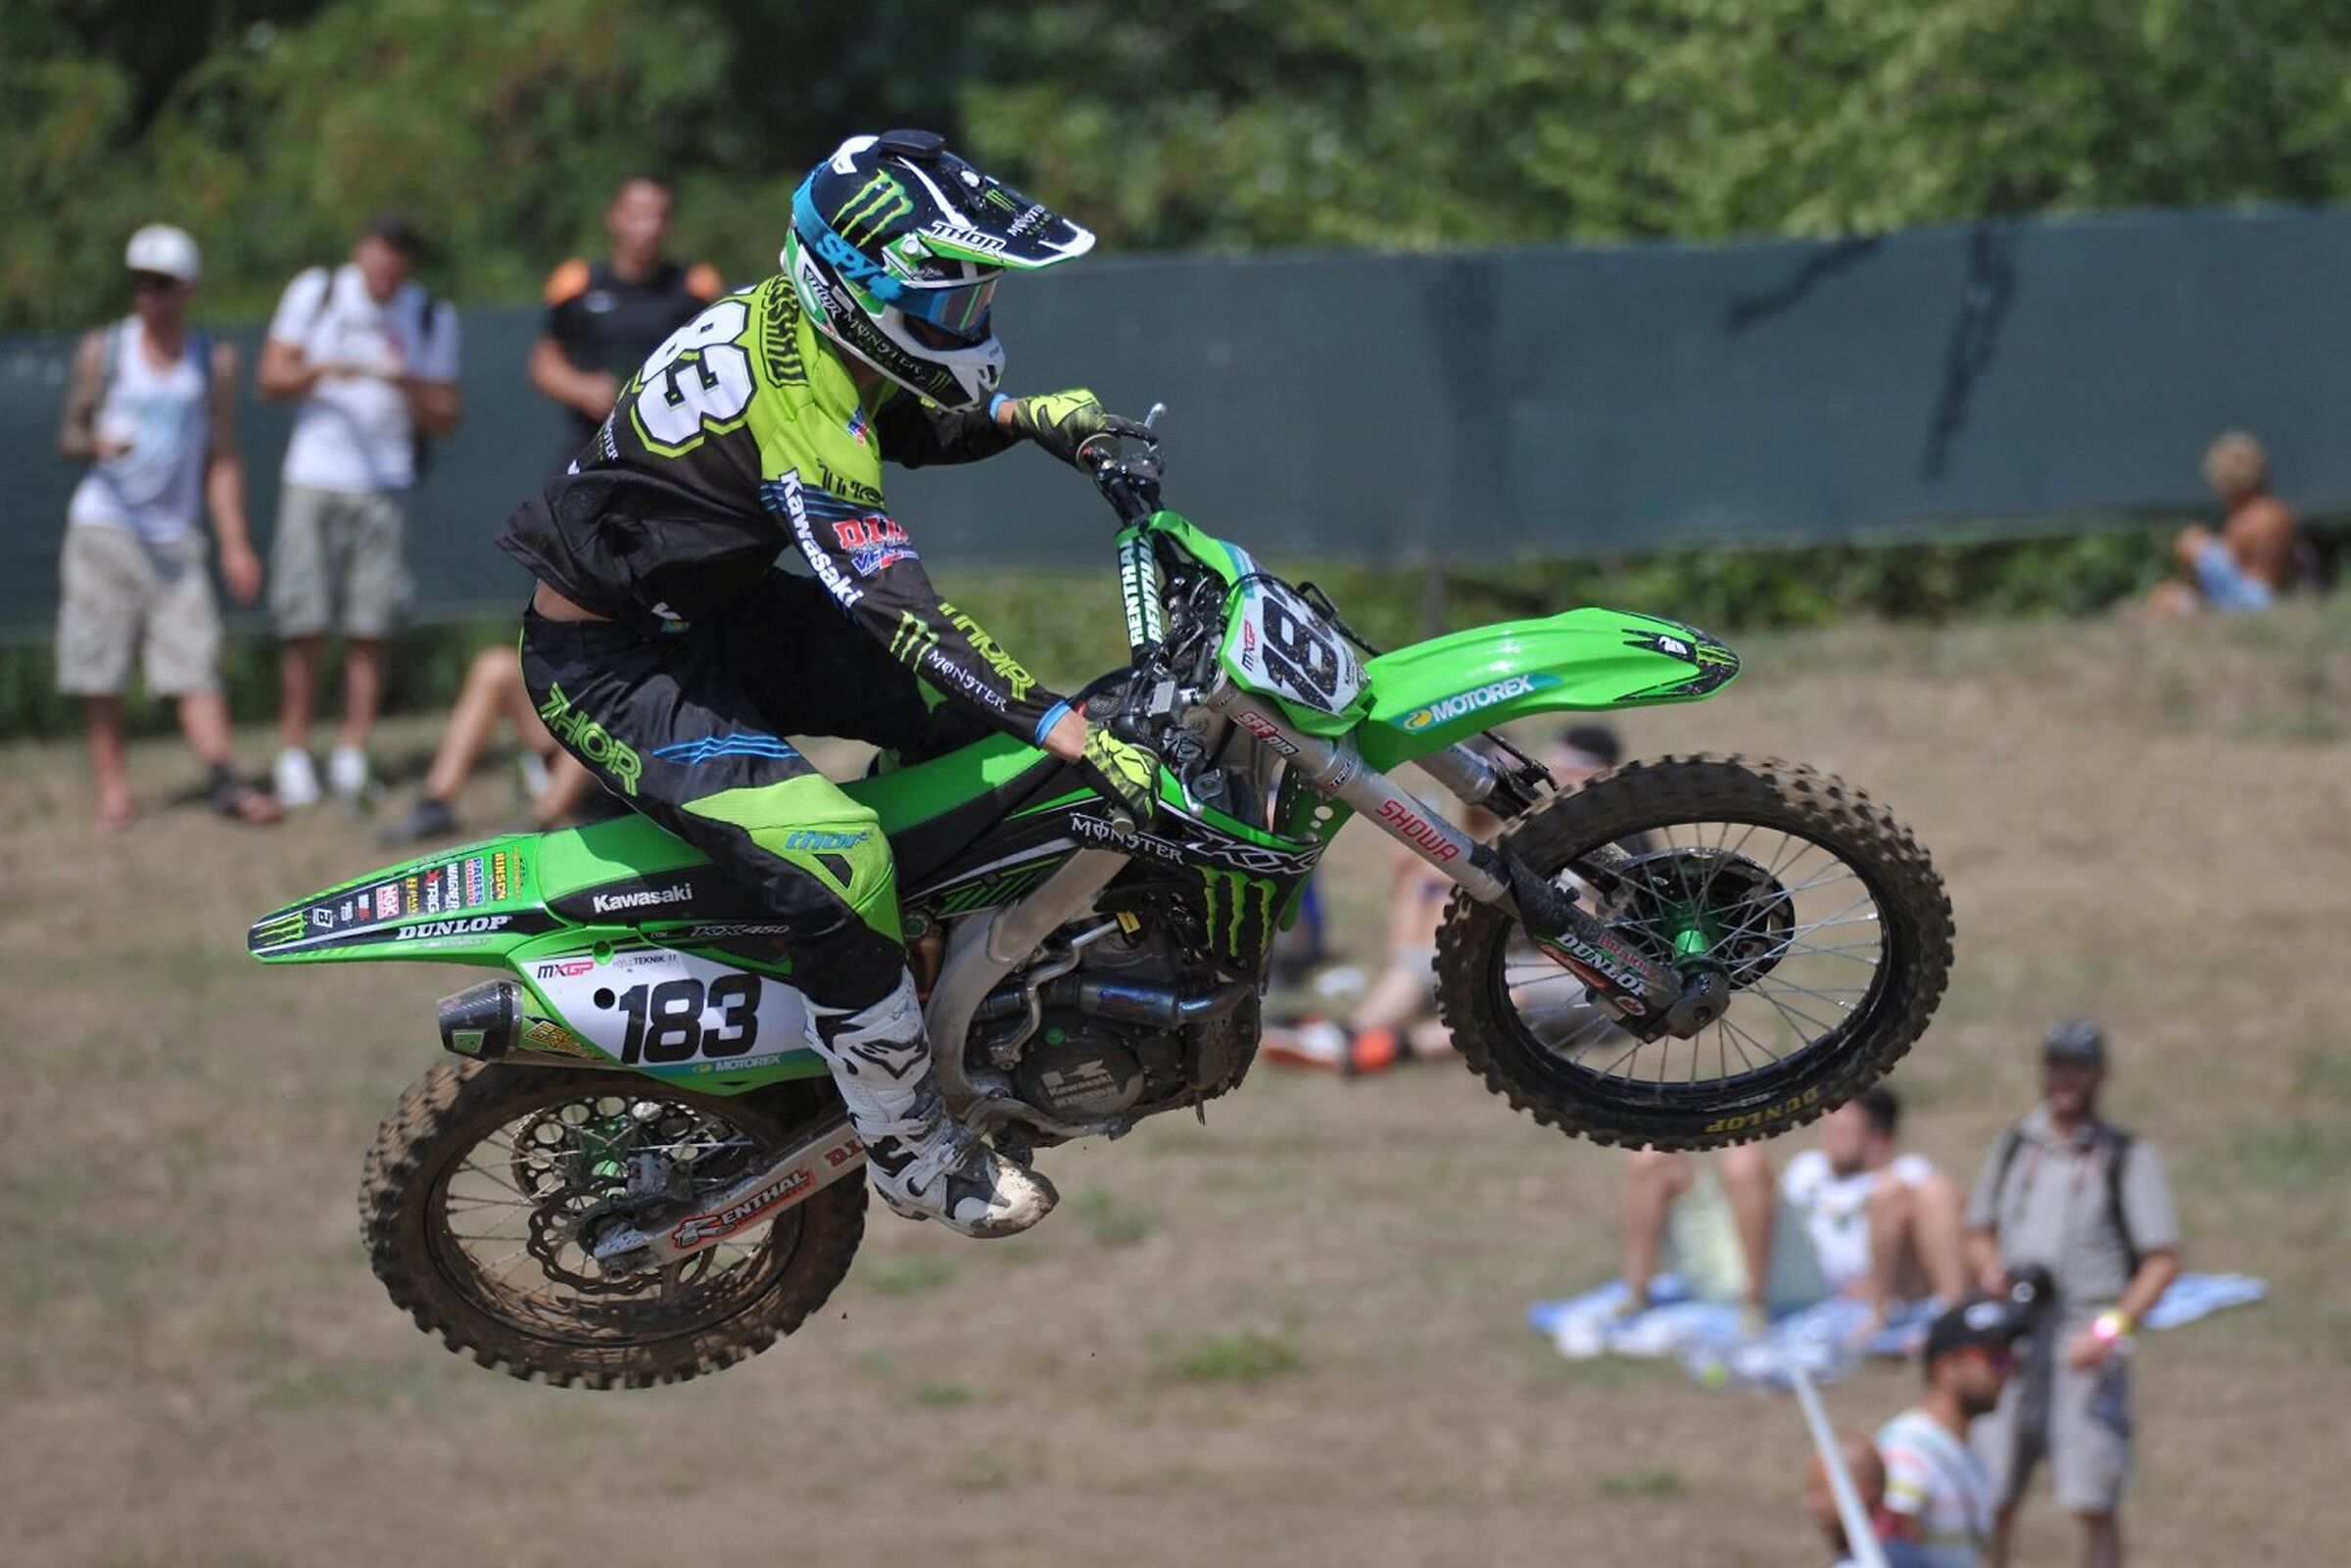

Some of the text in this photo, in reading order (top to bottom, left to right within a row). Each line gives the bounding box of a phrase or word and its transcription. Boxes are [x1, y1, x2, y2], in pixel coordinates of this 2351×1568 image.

[779, 467, 864, 607] Kawasaki
[928, 649, 1006, 712] MONSTER
[1431, 675, 1533, 721] MOTOREX
[540, 682, 643, 796] THOR
[1071, 816, 1184, 864] MONSTER
[1375, 799, 1460, 863] SHOWA
[593, 882, 693, 913] Kawasaki
[397, 915, 508, 940] DUNLOP
[538, 962, 595, 979] MXGP
[619, 973, 762, 1065] 183
[716, 1054, 782, 1072] MOTOREX
[1704, 1087, 1821, 1134] DUNLOP
